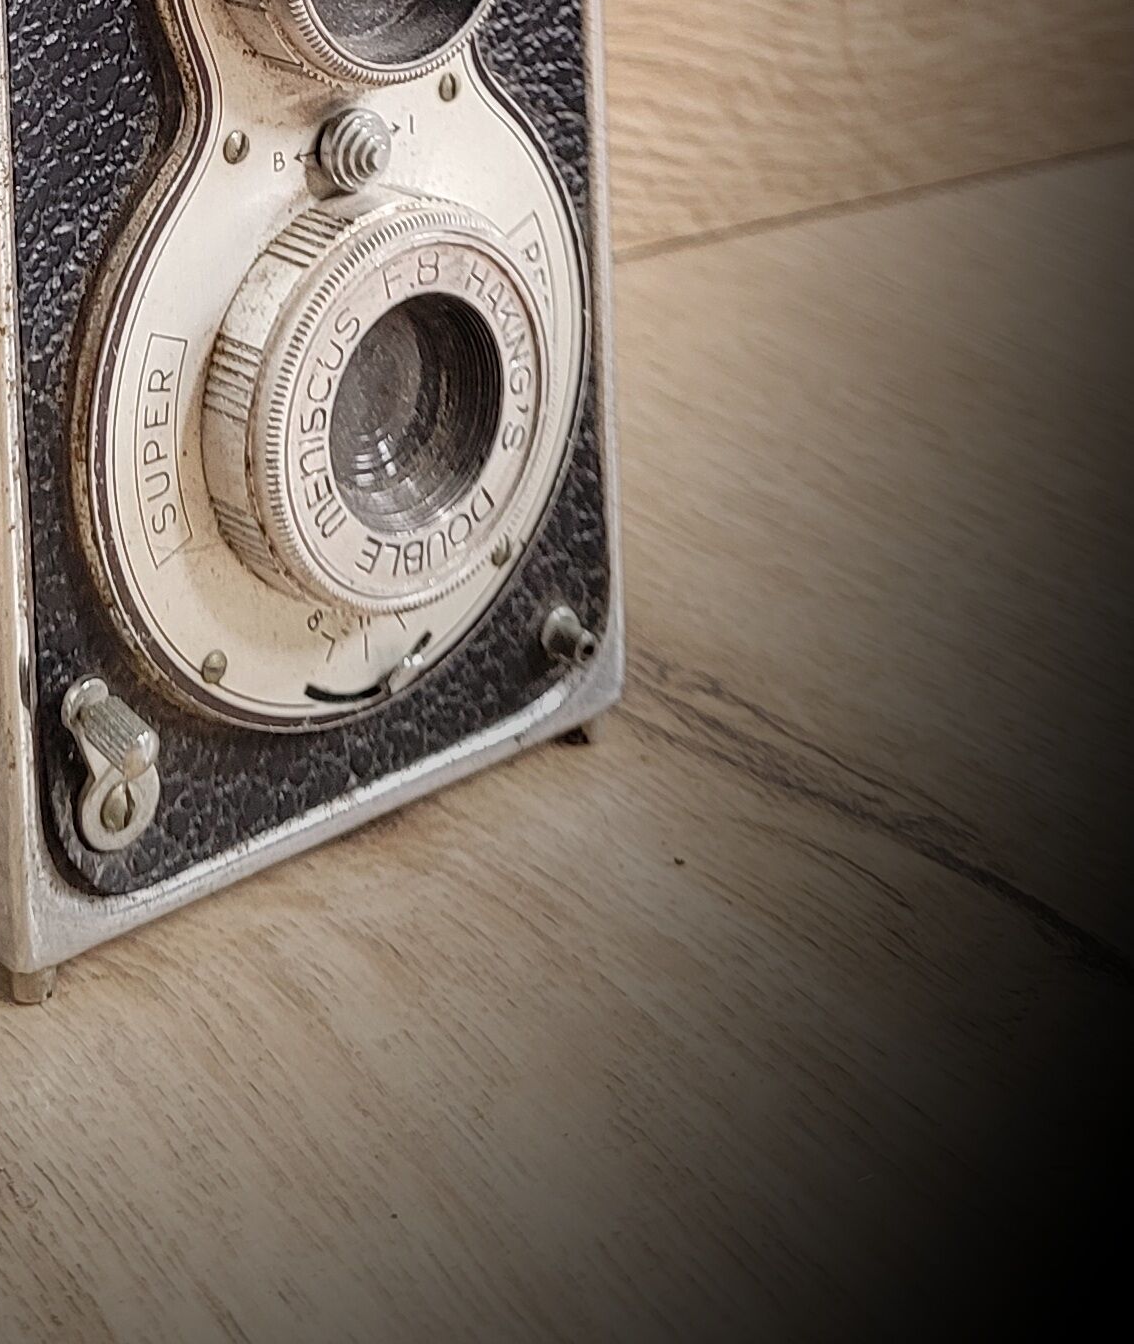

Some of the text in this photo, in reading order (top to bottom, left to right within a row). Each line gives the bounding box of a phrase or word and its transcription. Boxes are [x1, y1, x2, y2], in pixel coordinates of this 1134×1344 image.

[273, 151, 286, 172] B
[299, 306, 361, 539] MENISCUS
[466, 260, 533, 451] HAKING'S
[143, 368, 177, 535] SUPER
[355, 485, 495, 577] DOUBLE
